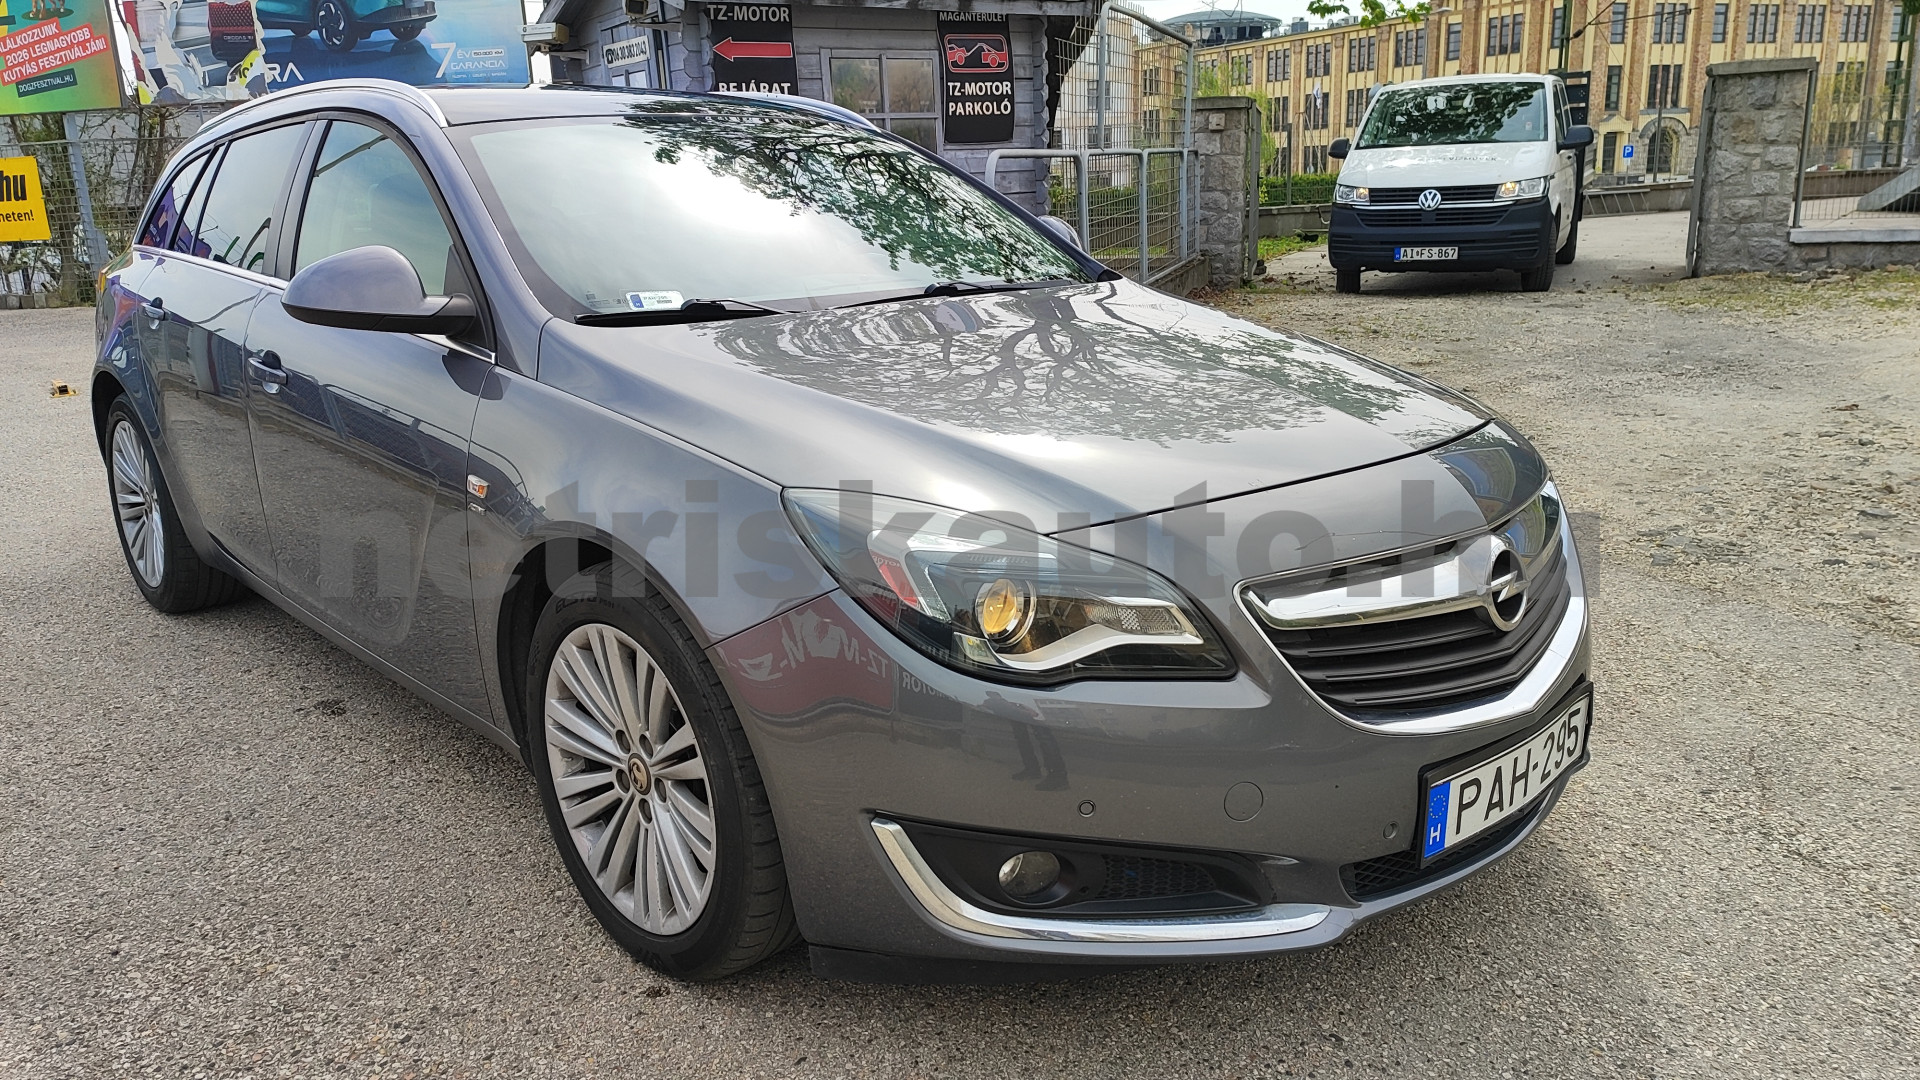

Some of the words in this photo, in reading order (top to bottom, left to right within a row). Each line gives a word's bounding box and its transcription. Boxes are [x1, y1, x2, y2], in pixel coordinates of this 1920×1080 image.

[707, 5, 790, 22] TZ-MOTOR
[6, 50, 29, 66] 2026
[30, 27, 91, 58] LEGNAGYOBB
[3, 61, 38, 82] KUTYÁS
[39, 37, 107, 70] FESZTIVÁLJÁN!
[431, 42, 456, 78] 7
[451, 60, 506, 70] GARANCIA
[947, 82, 1011, 96] TZ-MOTOR
[948, 98, 1011, 116] PARKOLÓ
[1420, 248, 1456, 258] FS-867
[1455, 708, 1581, 835] PAH-295
[1430, 823, 1441, 845] H
